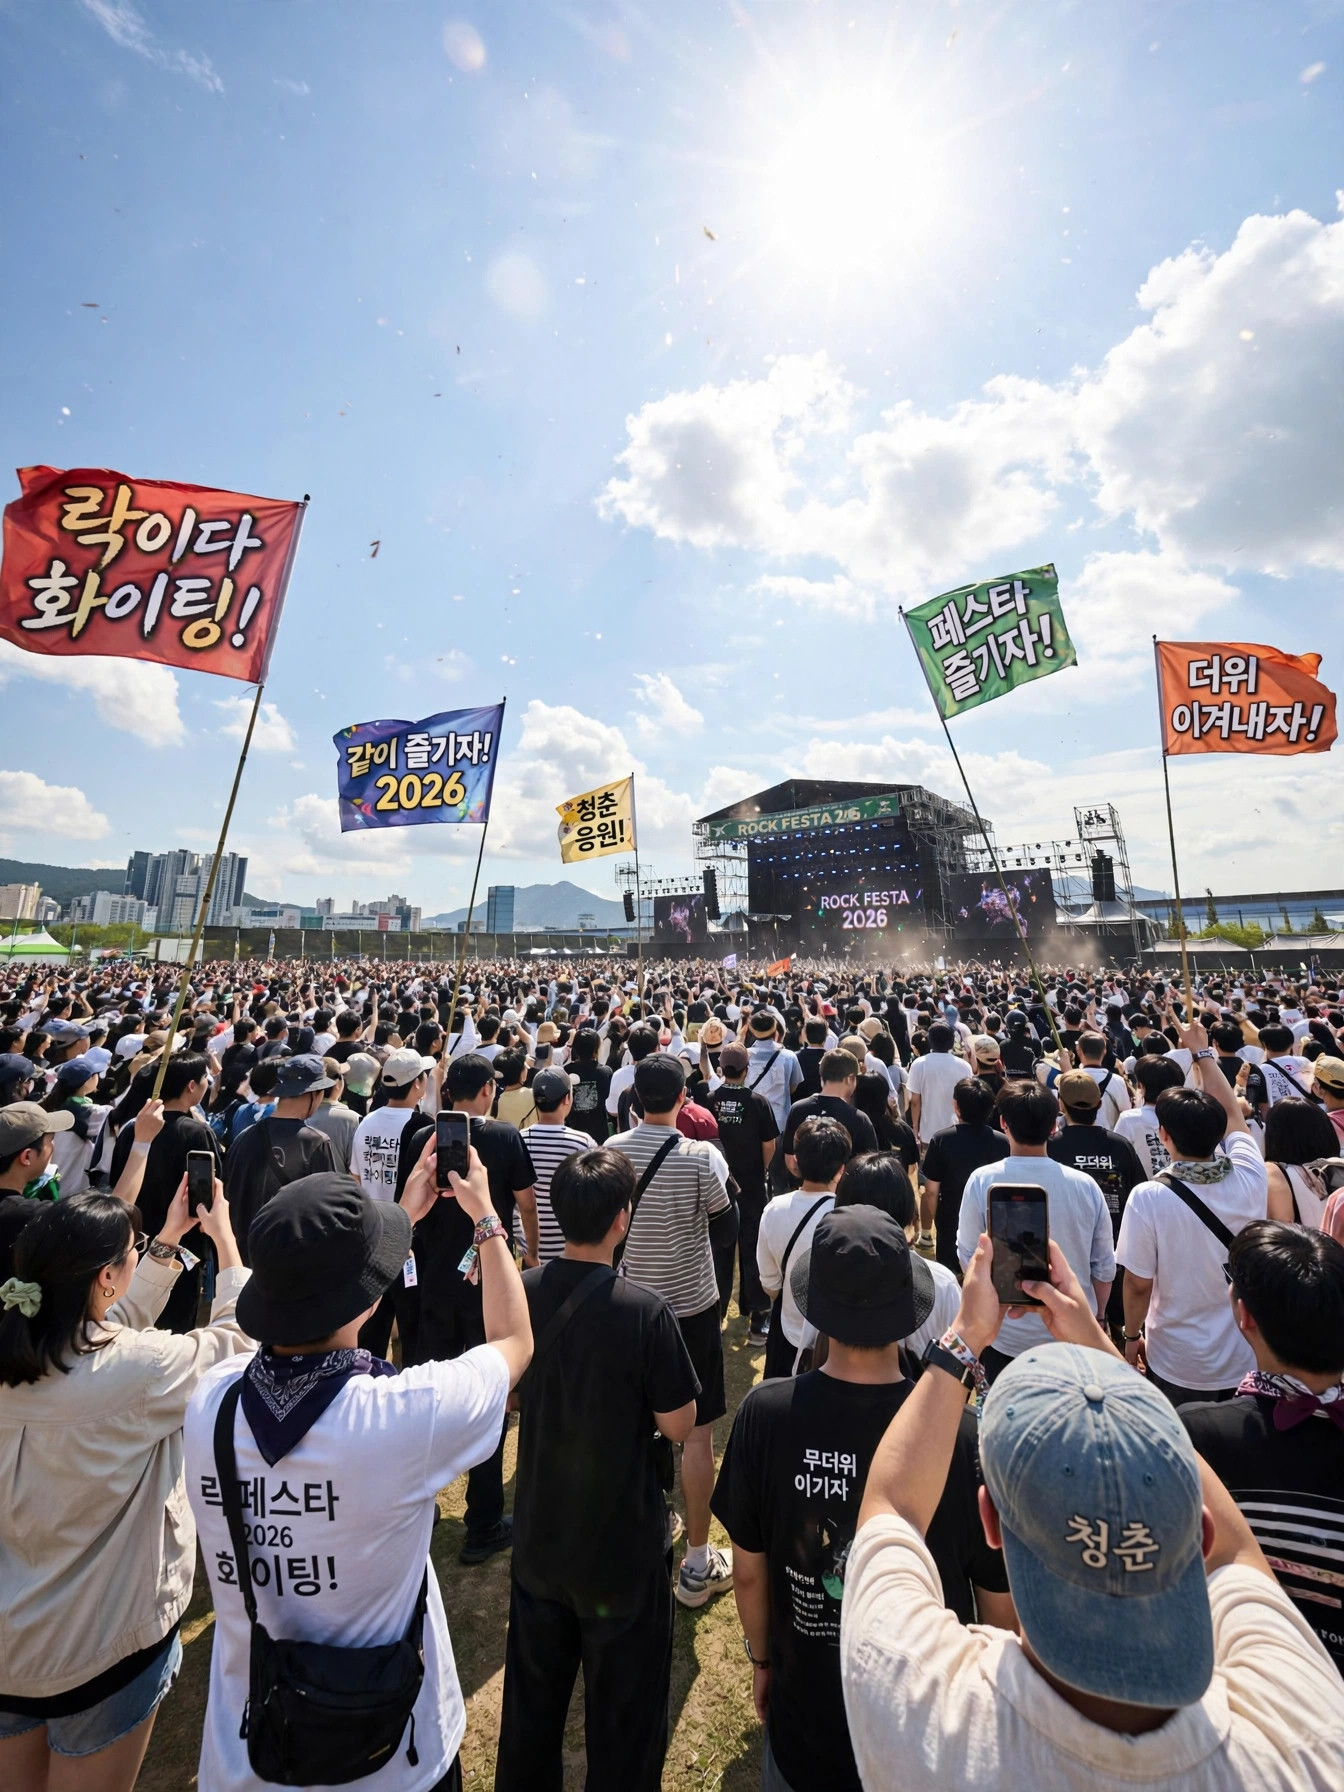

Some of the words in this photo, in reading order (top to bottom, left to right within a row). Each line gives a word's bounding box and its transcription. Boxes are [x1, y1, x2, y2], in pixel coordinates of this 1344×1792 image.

[61, 485, 262, 572] 락이다
[21, 560, 261, 648] 화이팅!
[927, 579, 1030, 651] 페스타
[942, 614, 1054, 702] 즐기자!
[1189, 655, 1257, 693] 더위
[1172, 701, 1324, 742] 이겨내자!
[347, 738, 397, 778] 같이
[404, 731, 492, 769] 즐기자!
[375, 772, 466, 812] 2026
[576, 792, 617, 822] 청춘
[575, 819, 624, 853] 응원!
[738, 819, 778, 836] ROCK
[781, 812, 833, 830] FESTA
[821, 893, 860, 909] ROCK
[864, 890, 911, 906] FESTA
[842, 908, 888, 929] 2026
[803, 1448, 856, 1478] 무더위
[794, 1473, 849, 1502] 이기자
[242, 1524, 293, 1548] 2026
[1065, 1514, 1160, 1571] 청춘
